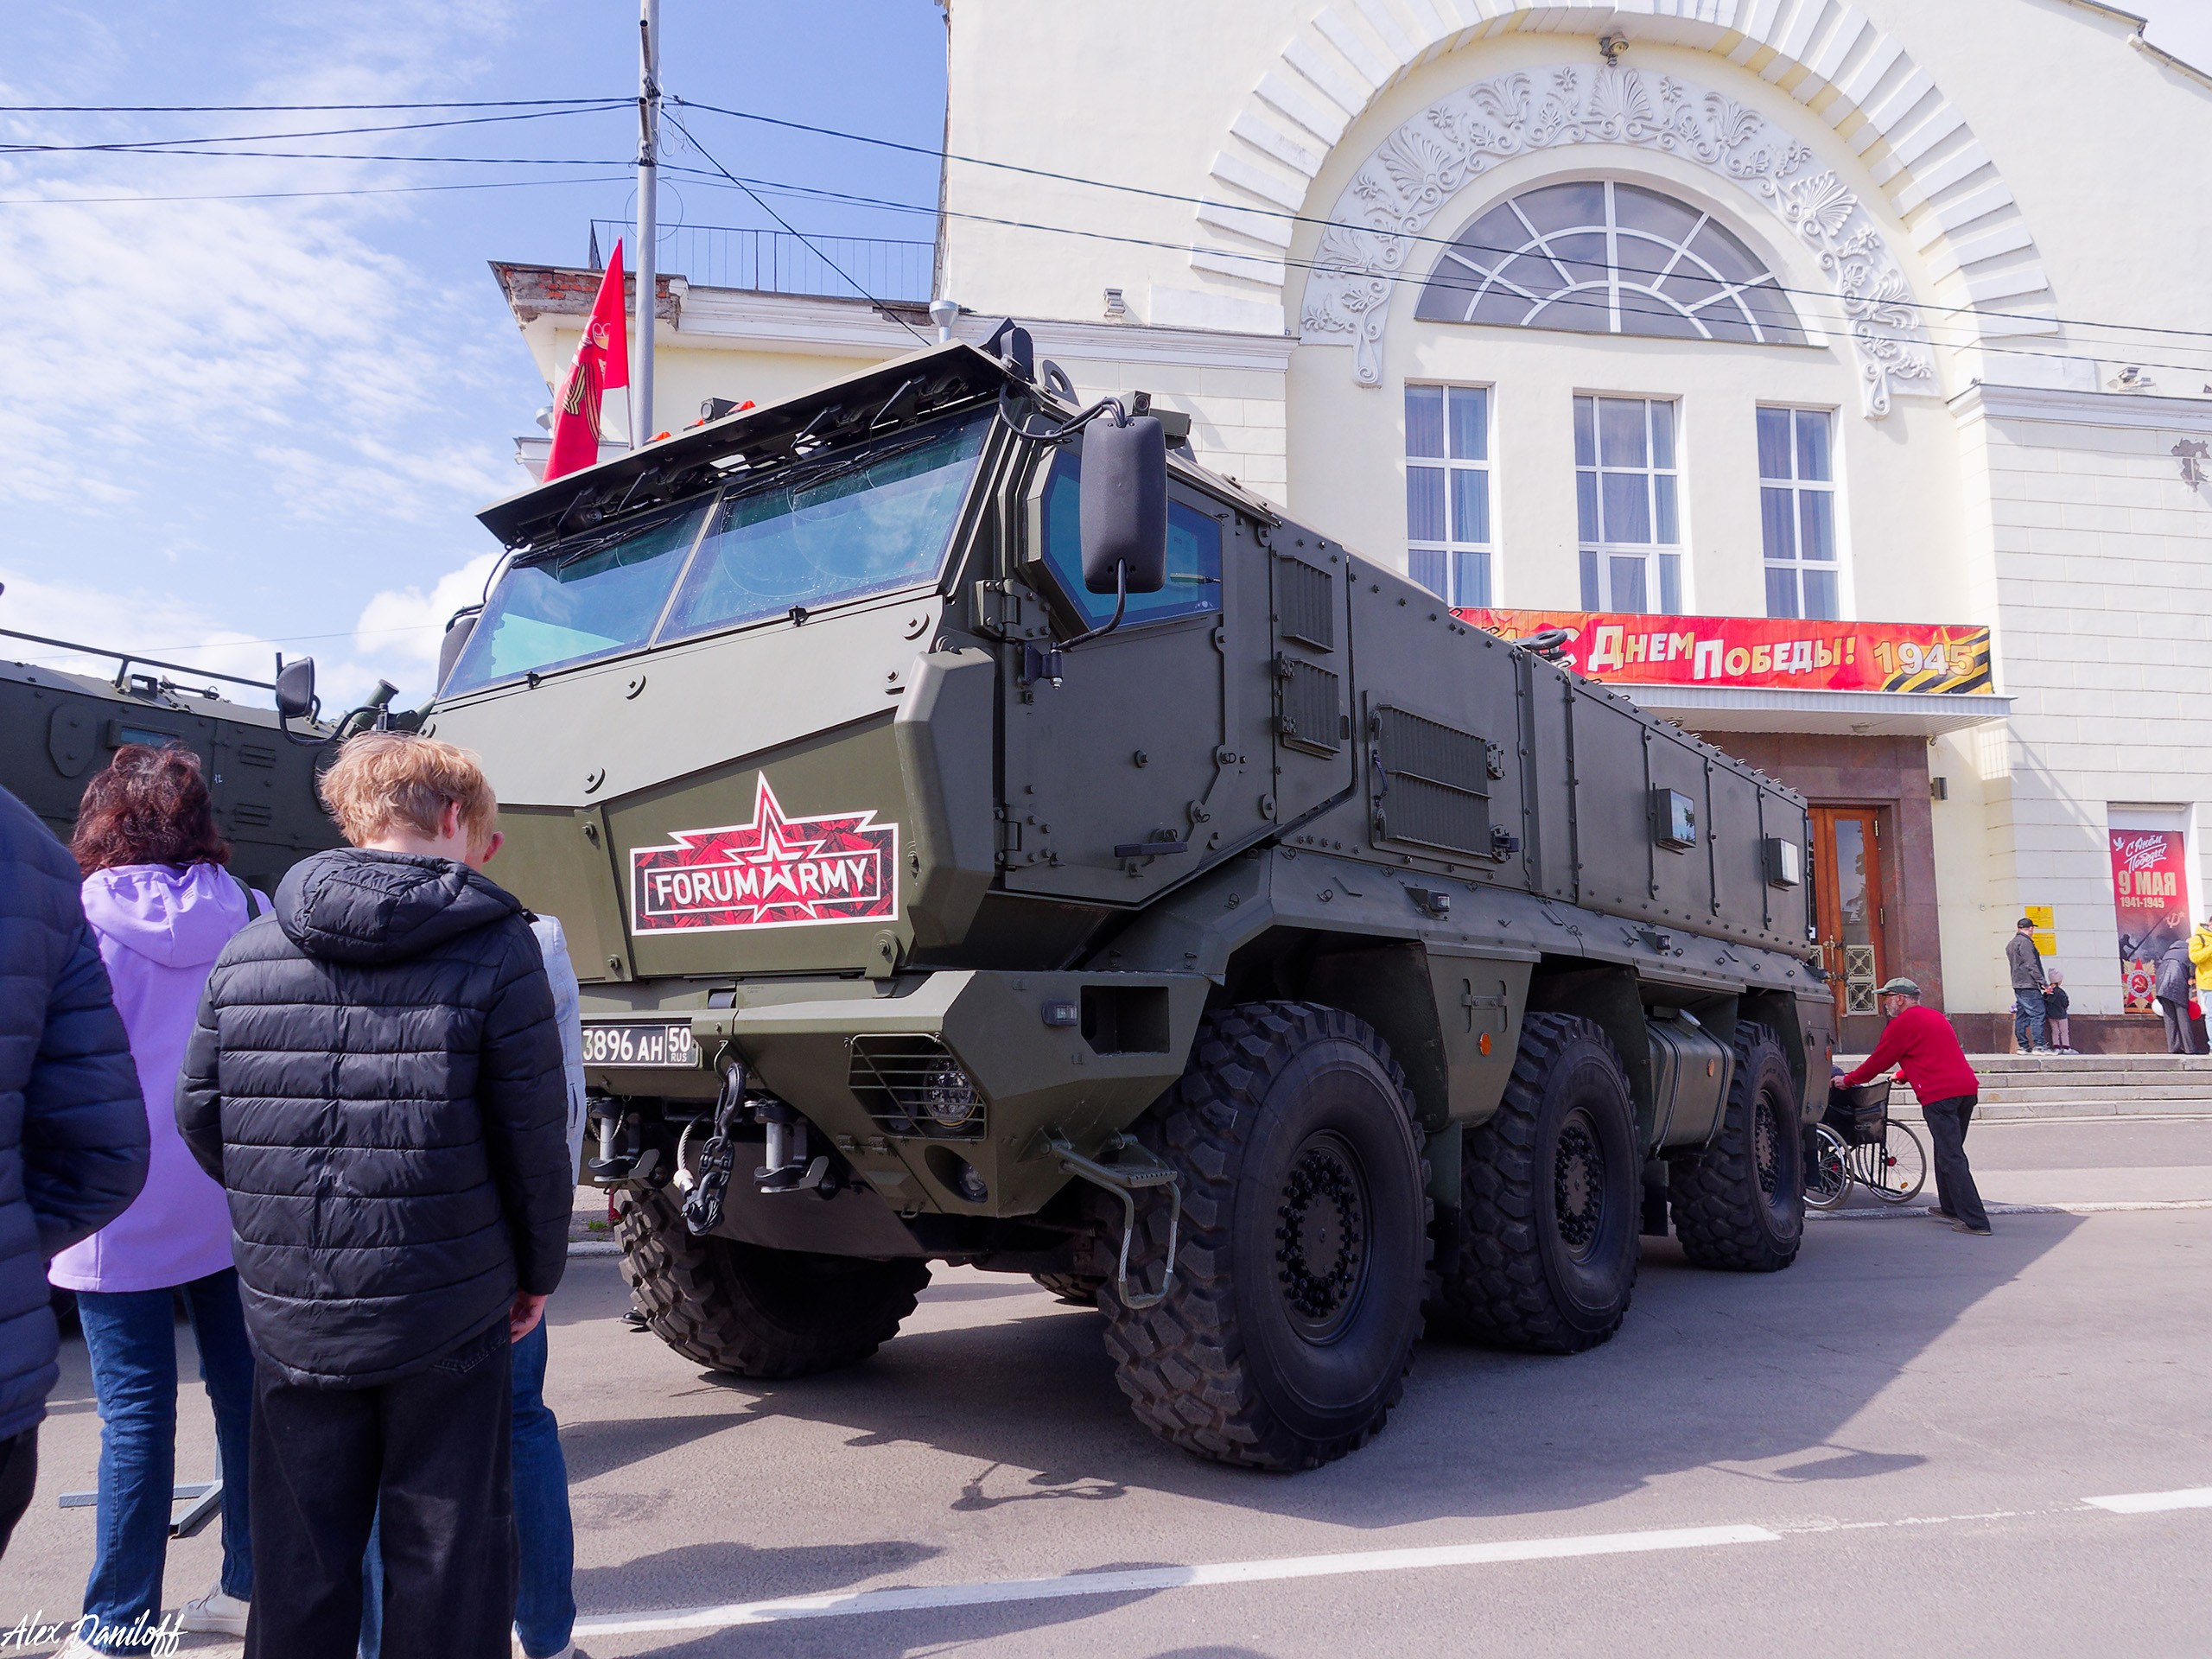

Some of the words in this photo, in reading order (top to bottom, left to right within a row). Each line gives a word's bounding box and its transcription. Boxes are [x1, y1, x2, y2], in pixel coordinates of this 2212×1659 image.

[1873, 641, 1976, 677] 1945
[655, 866, 760, 906] FORUM
[2118, 870, 2132, 895] 9
[2135, 871, 2177, 896] МАЯ
[2120, 897, 2164, 908] 1941-1945
[582, 1029, 633, 1061] 3896
[637, 1035, 664, 1061] АН
[668, 1027, 691, 1052] 50
[671, 1052, 688, 1063] RUS
